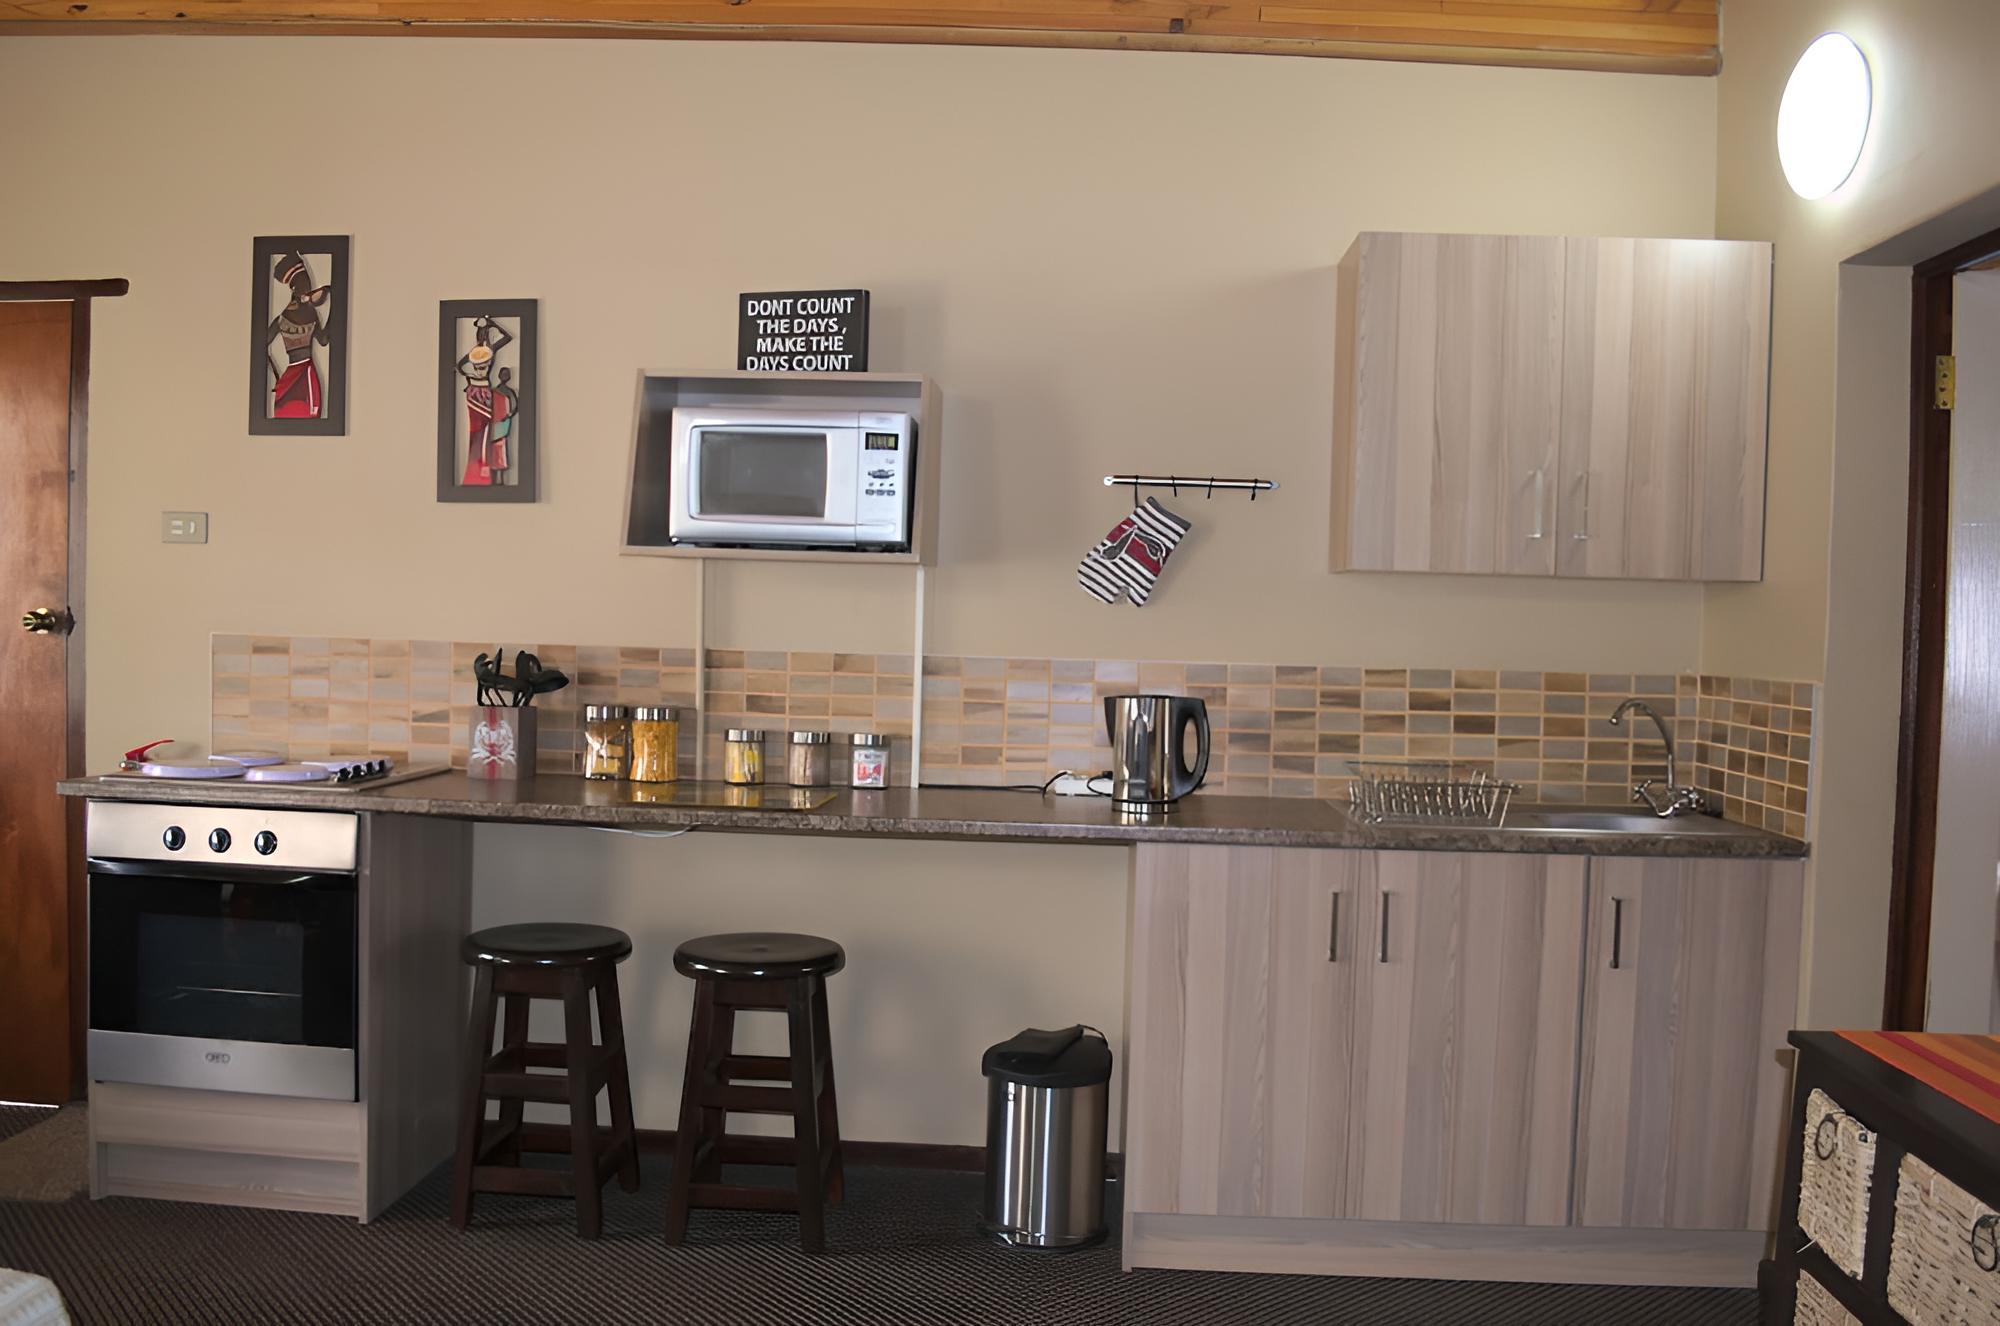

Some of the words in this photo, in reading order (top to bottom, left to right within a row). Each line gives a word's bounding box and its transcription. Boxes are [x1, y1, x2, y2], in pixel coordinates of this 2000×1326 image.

[748, 299, 793, 317] DONT
[797, 297, 855, 315] COUNT
[757, 319, 790, 334] THE
[756, 337, 807, 352] MAKE
[809, 336, 844, 352] THE
[746, 356, 789, 371] DAYS
[792, 355, 853, 371] COUNT
